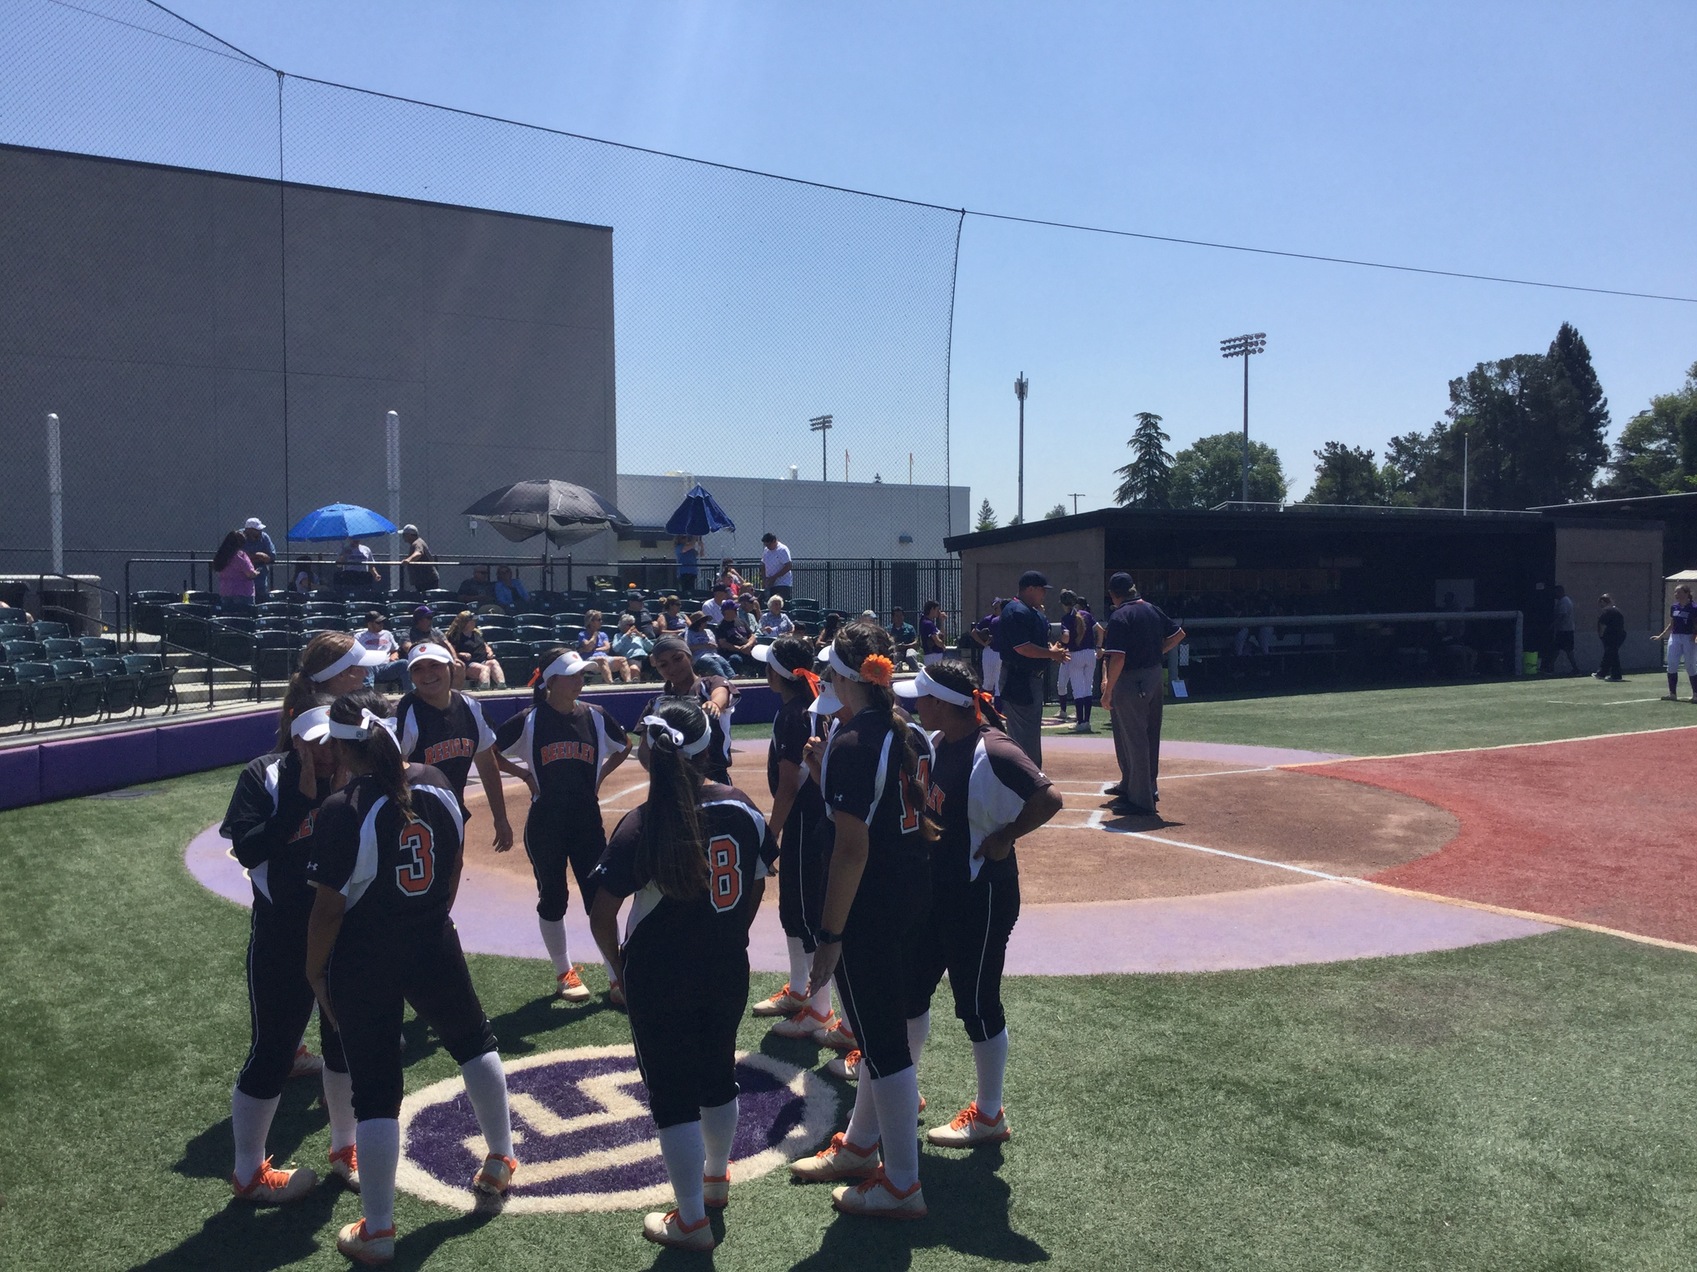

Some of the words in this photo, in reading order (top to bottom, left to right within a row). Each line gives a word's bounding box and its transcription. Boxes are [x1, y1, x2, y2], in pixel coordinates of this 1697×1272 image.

[540, 740, 595, 767] REEDLEY
[395, 818, 435, 897] 3
[708, 834, 743, 913] 8
